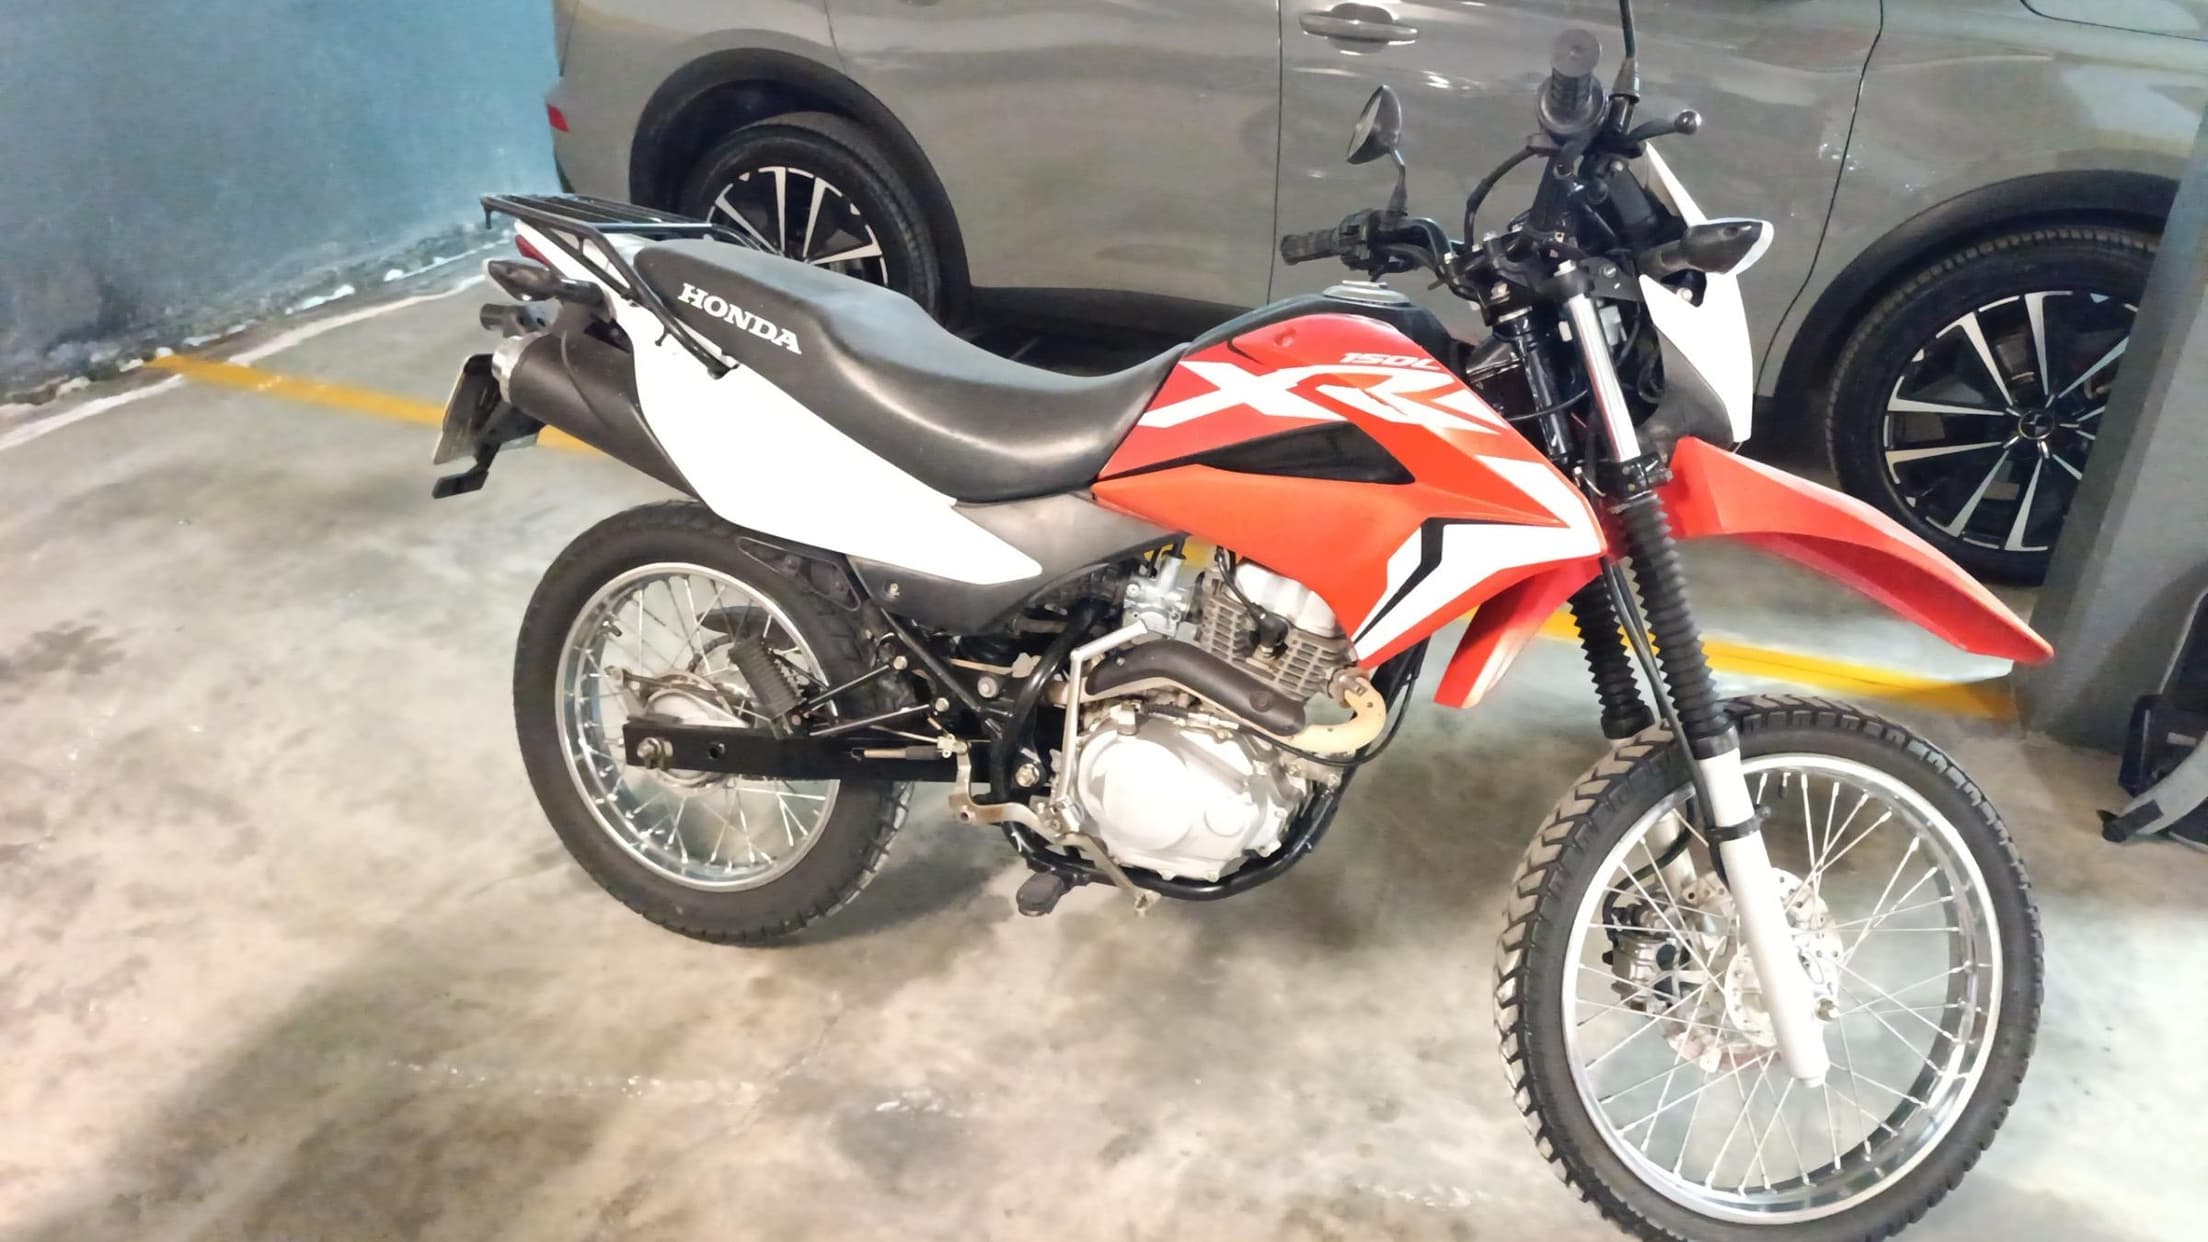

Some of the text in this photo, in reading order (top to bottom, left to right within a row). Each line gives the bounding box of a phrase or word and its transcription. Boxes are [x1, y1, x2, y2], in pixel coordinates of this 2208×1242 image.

[677, 282, 802, 355] HONDA
[1137, 360, 1508, 436] XR
[1339, 352, 1442, 371] 150L
